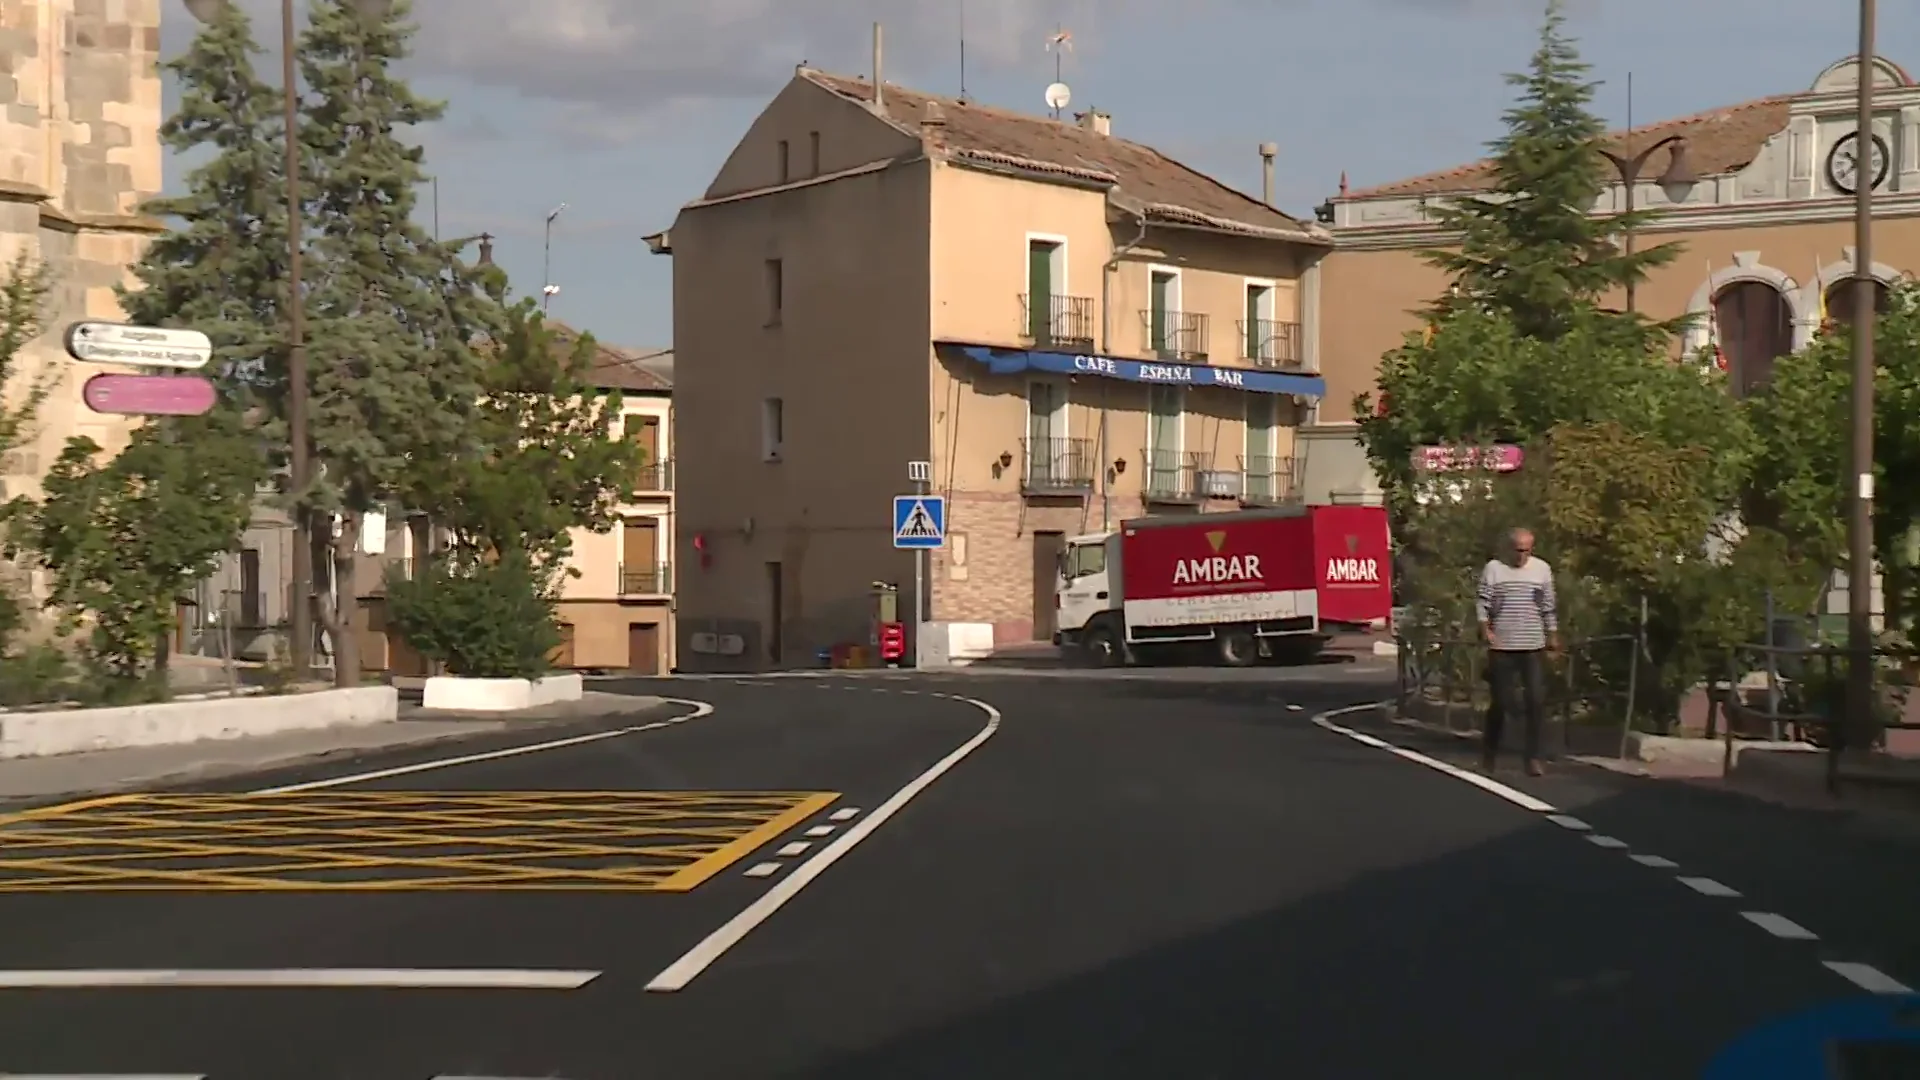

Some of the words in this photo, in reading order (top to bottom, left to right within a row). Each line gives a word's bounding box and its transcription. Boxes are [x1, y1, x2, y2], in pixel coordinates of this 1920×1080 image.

[1074, 355, 1117, 374] CAFE
[1139, 365, 1191, 381] ESPAÑA
[1214, 368, 1243, 386] BAR
[1172, 555, 1264, 584] AMBAR
[1326, 558, 1380, 581] AMBAR
